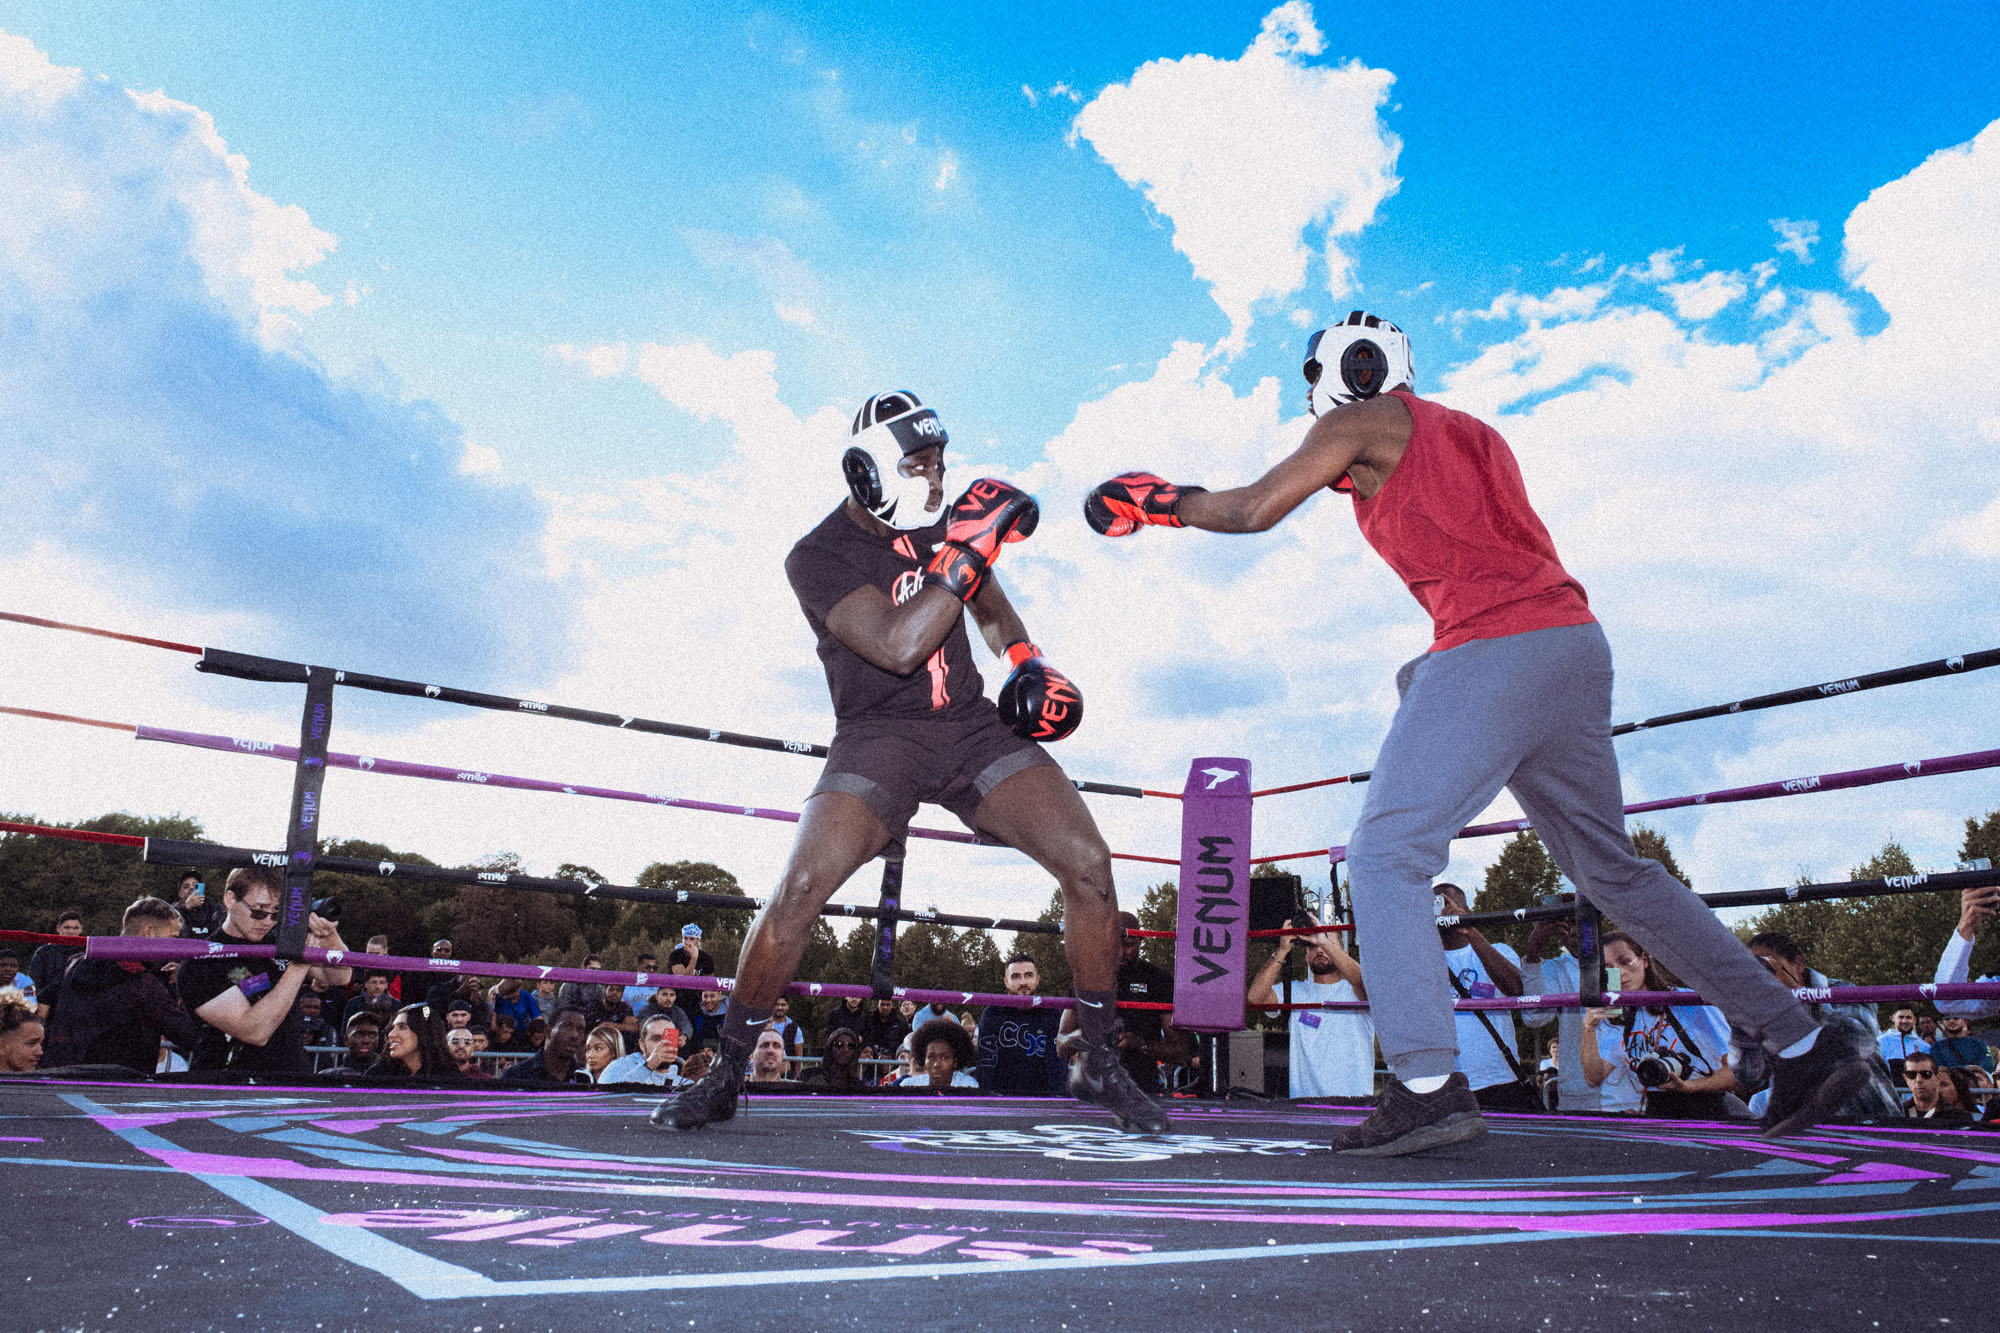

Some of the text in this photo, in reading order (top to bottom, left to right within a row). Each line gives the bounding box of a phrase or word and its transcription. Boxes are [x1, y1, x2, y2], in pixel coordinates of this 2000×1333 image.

[1818, 679, 1861, 695] VENUM
[310, 702, 326, 740] VENUM
[782, 739, 813, 754] VENUM
[1781, 776, 1821, 793] VENUM
[300, 791, 317, 830] VENUM
[1884, 872, 1928, 889] VENUM
[287, 886, 305, 927] VENUM
[1190, 835, 1241, 986] VENUM
[716, 977, 736, 991] VEN
[1791, 986, 1832, 1002] VENUM
